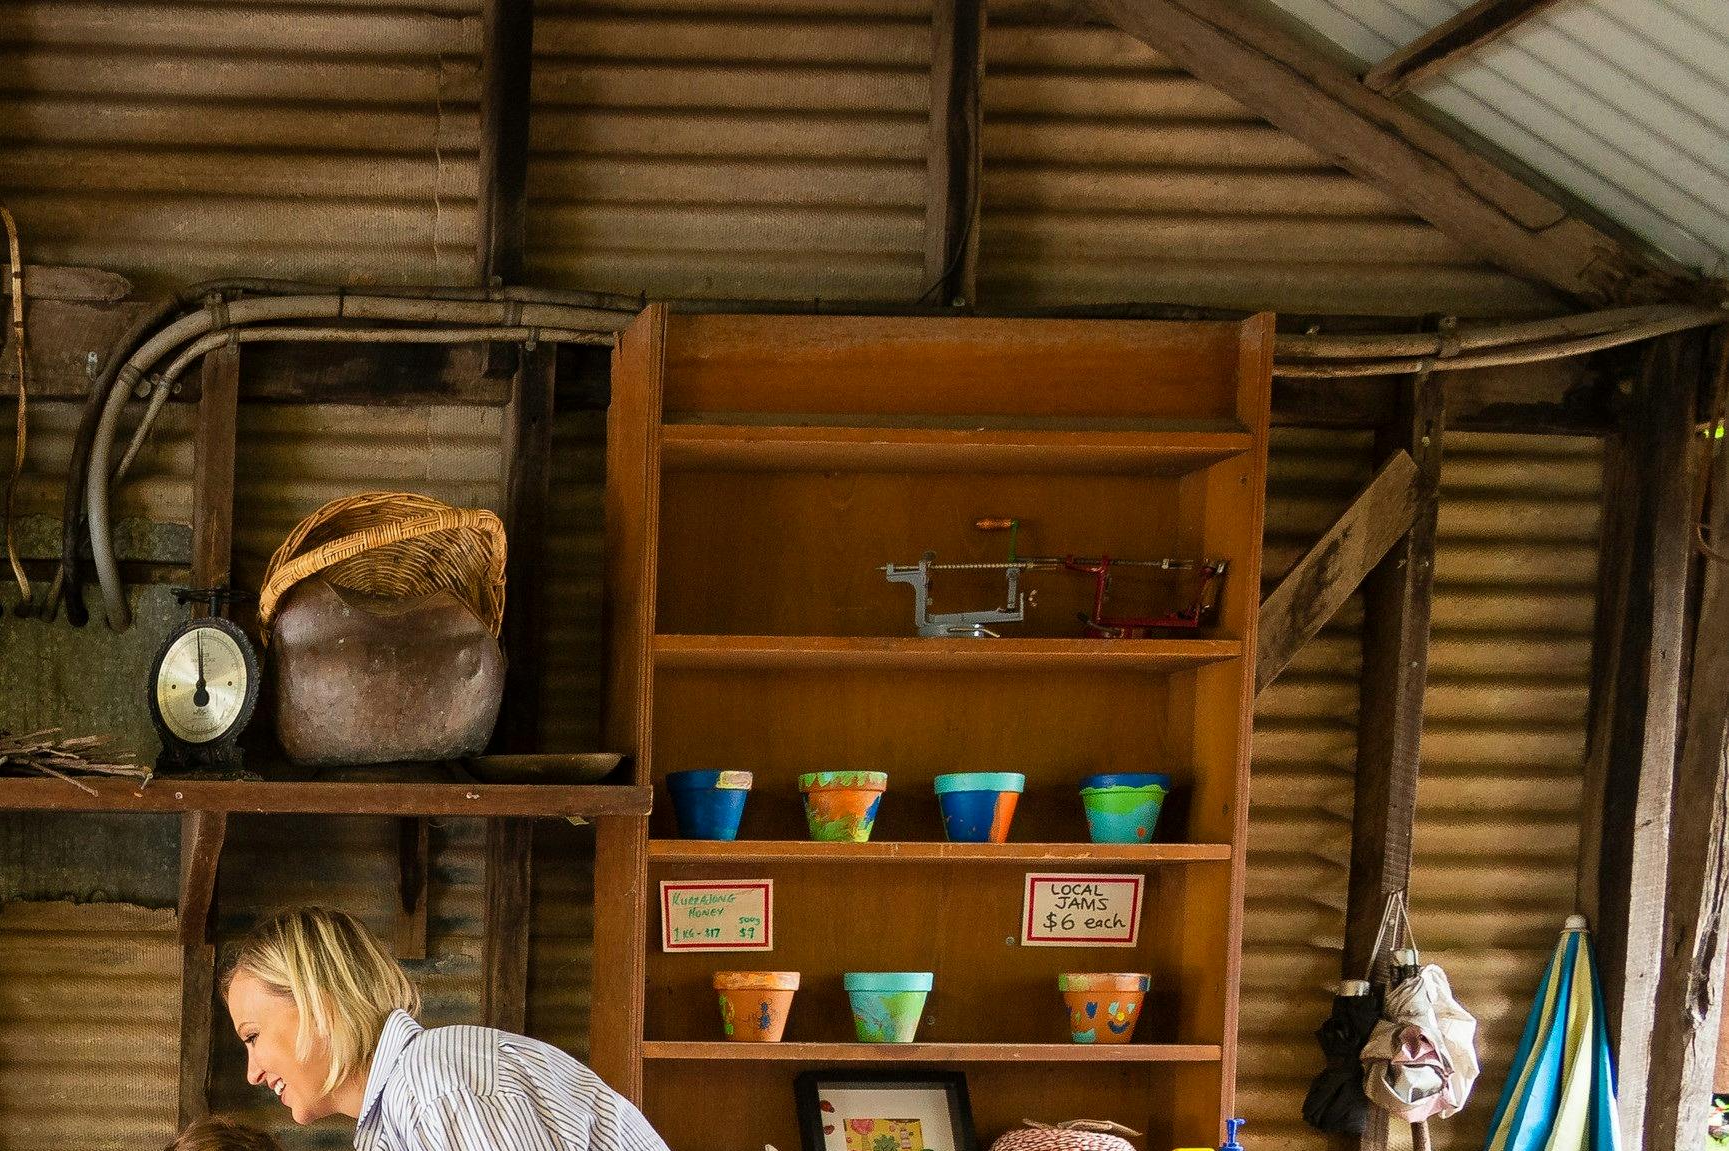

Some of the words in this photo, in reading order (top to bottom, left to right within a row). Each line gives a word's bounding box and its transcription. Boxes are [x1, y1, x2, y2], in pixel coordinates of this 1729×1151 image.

[1050, 883, 1104, 897] LOCAL
[1055, 896, 1109, 911] JAMS
[687, 906, 724, 918] HONEY
[1042, 911, 1076, 933] $6
[1084, 913, 1127, 929] each
[704, 927, 721, 938] $17
[738, 926, 755, 939] $9
